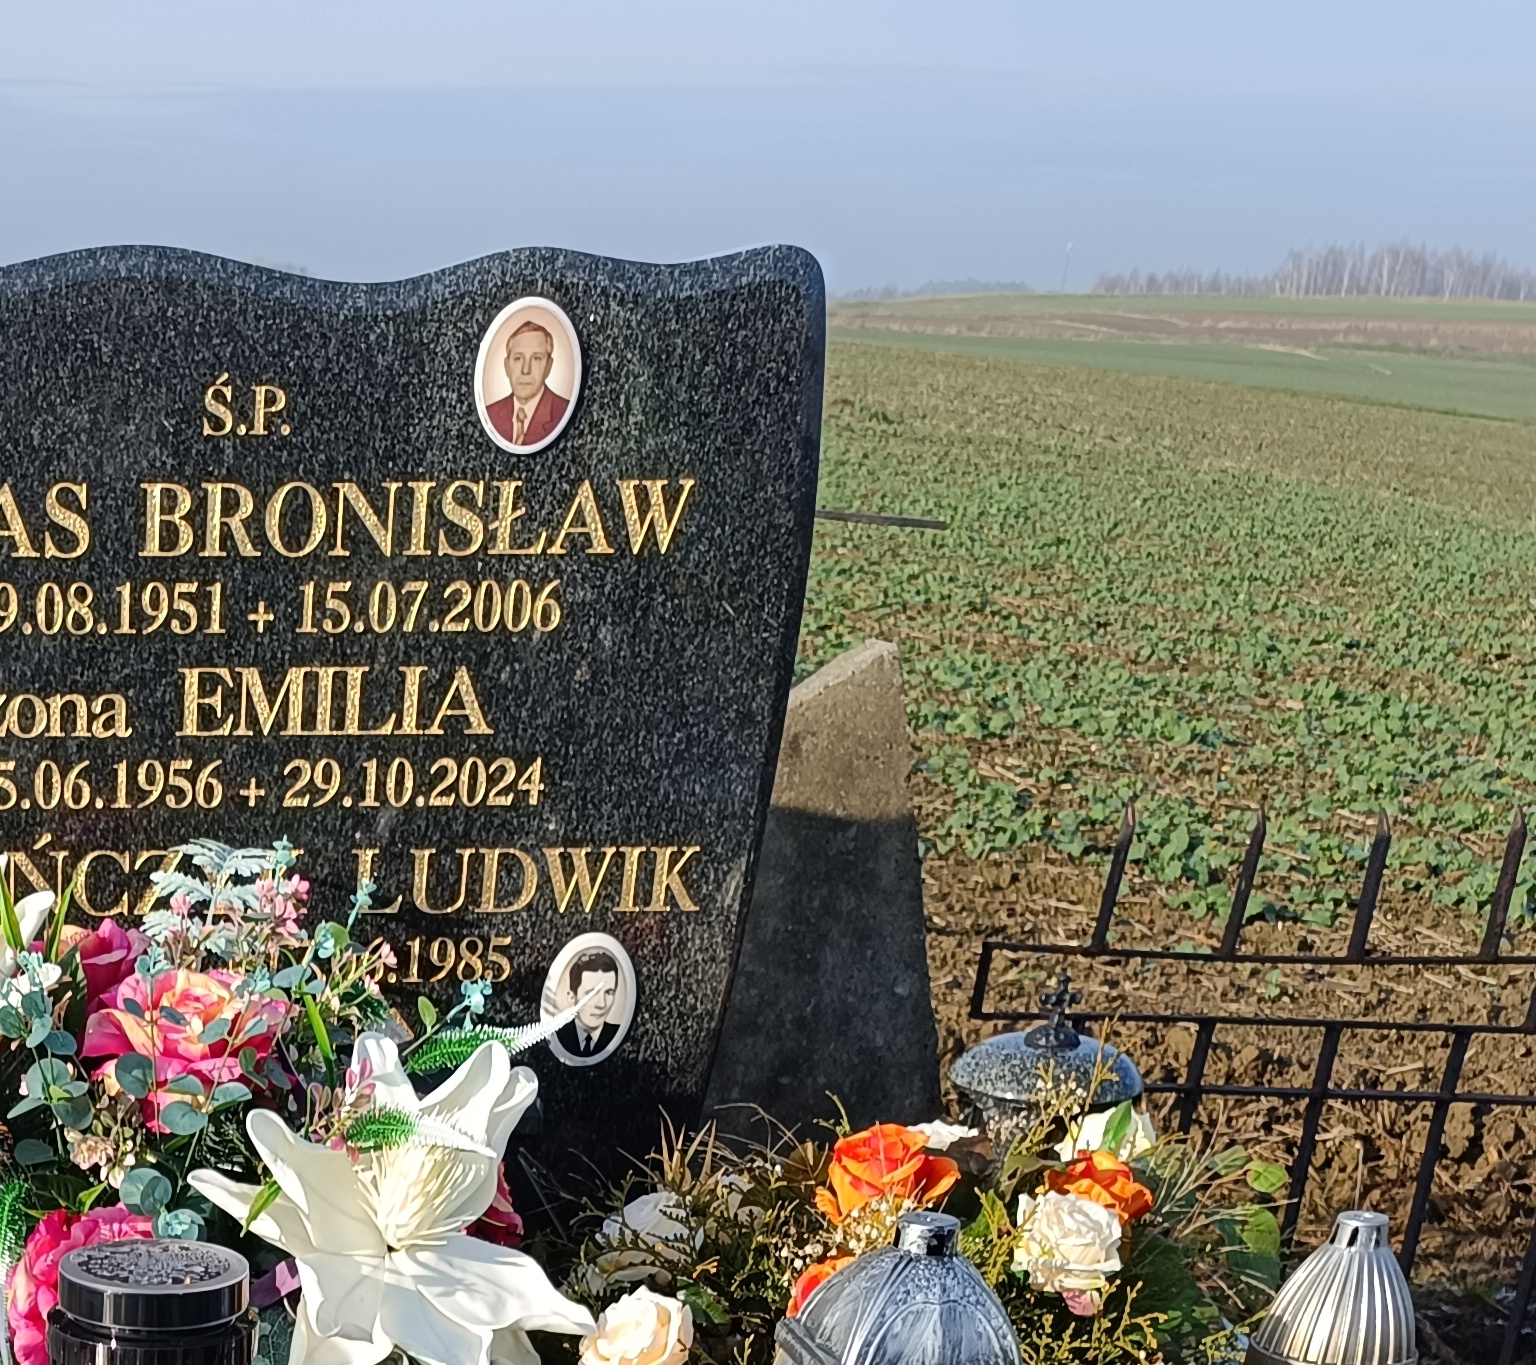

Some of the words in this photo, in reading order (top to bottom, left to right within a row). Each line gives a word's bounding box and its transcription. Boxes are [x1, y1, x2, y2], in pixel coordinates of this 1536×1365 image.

[202, 373, 293, 438] Ś.P.
[137, 478, 697, 559] BRONISŁAW
[295, 578, 563, 635] 15.07.2006
[175, 665, 495, 738] EMILIA
[282, 755, 547, 809] 29.10.2024
[351, 845, 703, 914] LUDWIK
